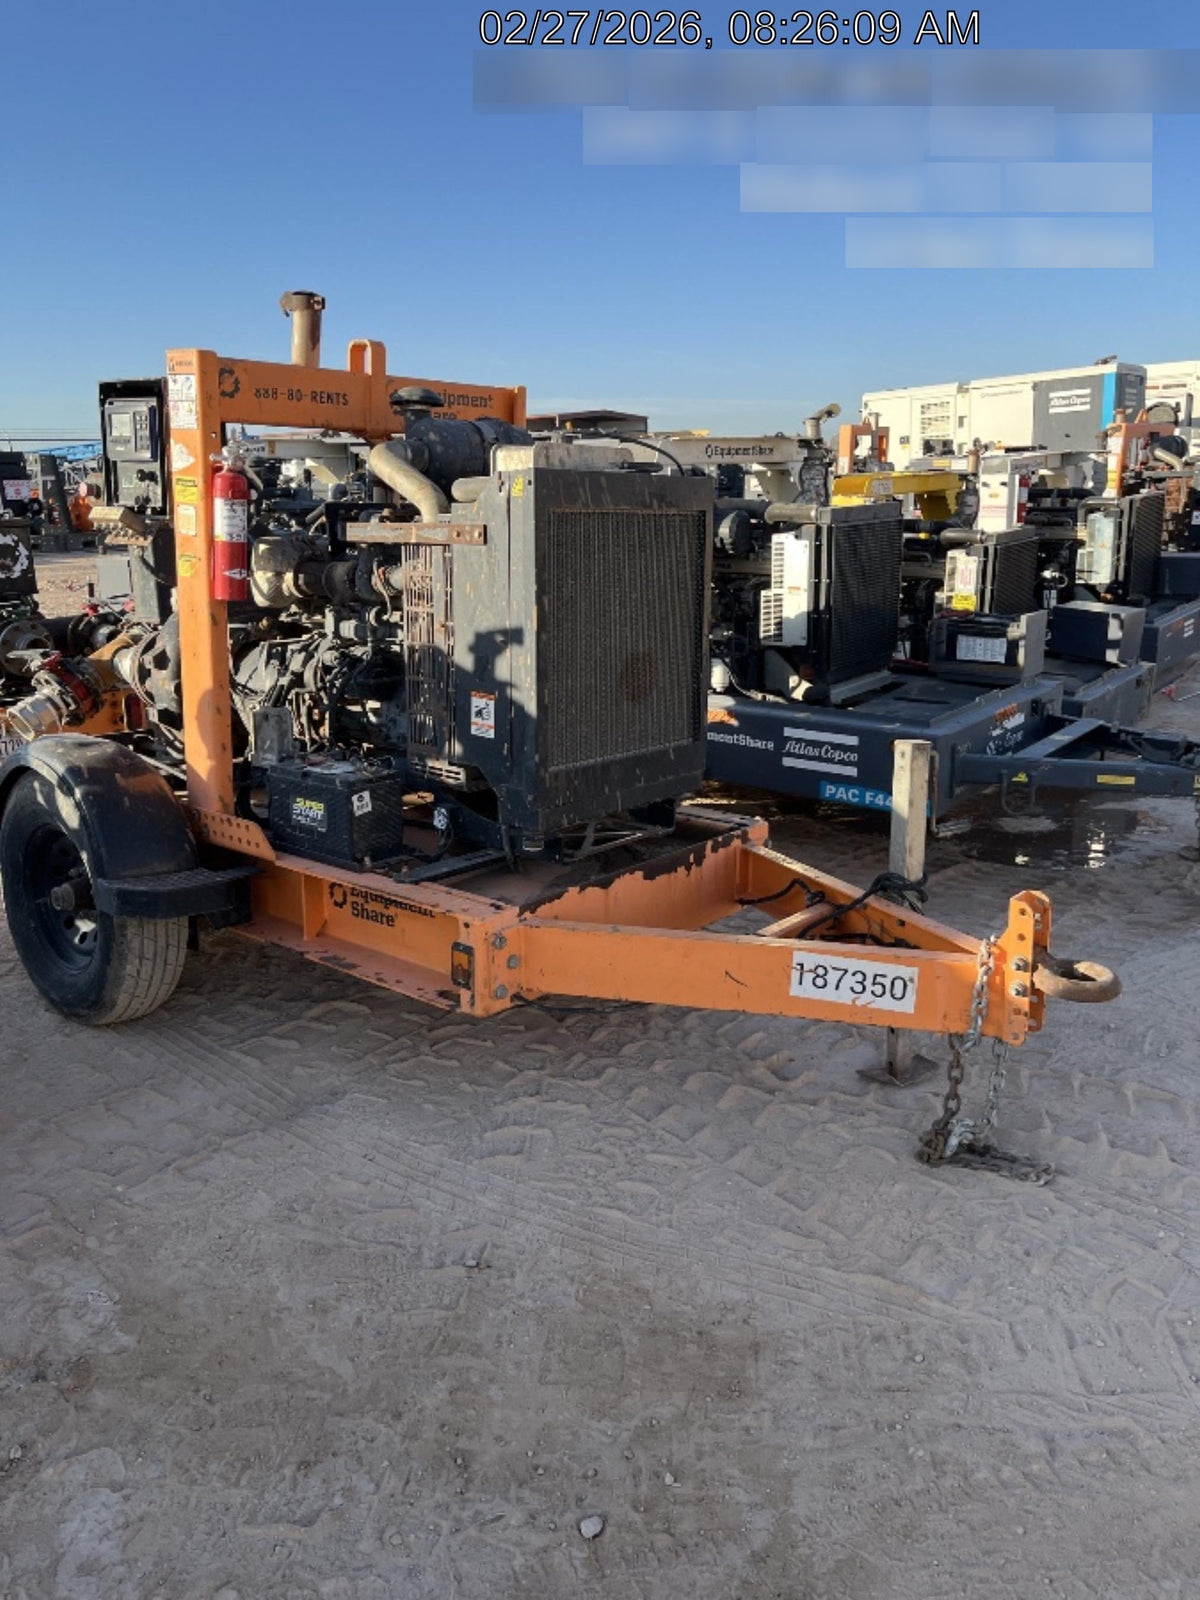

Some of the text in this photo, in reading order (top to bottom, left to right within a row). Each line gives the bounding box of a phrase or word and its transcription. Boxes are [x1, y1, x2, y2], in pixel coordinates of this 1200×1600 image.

[440, 389, 494, 408] ipment
[433, 411, 457, 420] are
[782, 740, 858, 762] Atlas Copco
[825, 785, 860, 802] PAC
[293, 804, 322, 819] START
[351, 901, 396, 927] Share
[796, 963, 908, 1001] 187350
